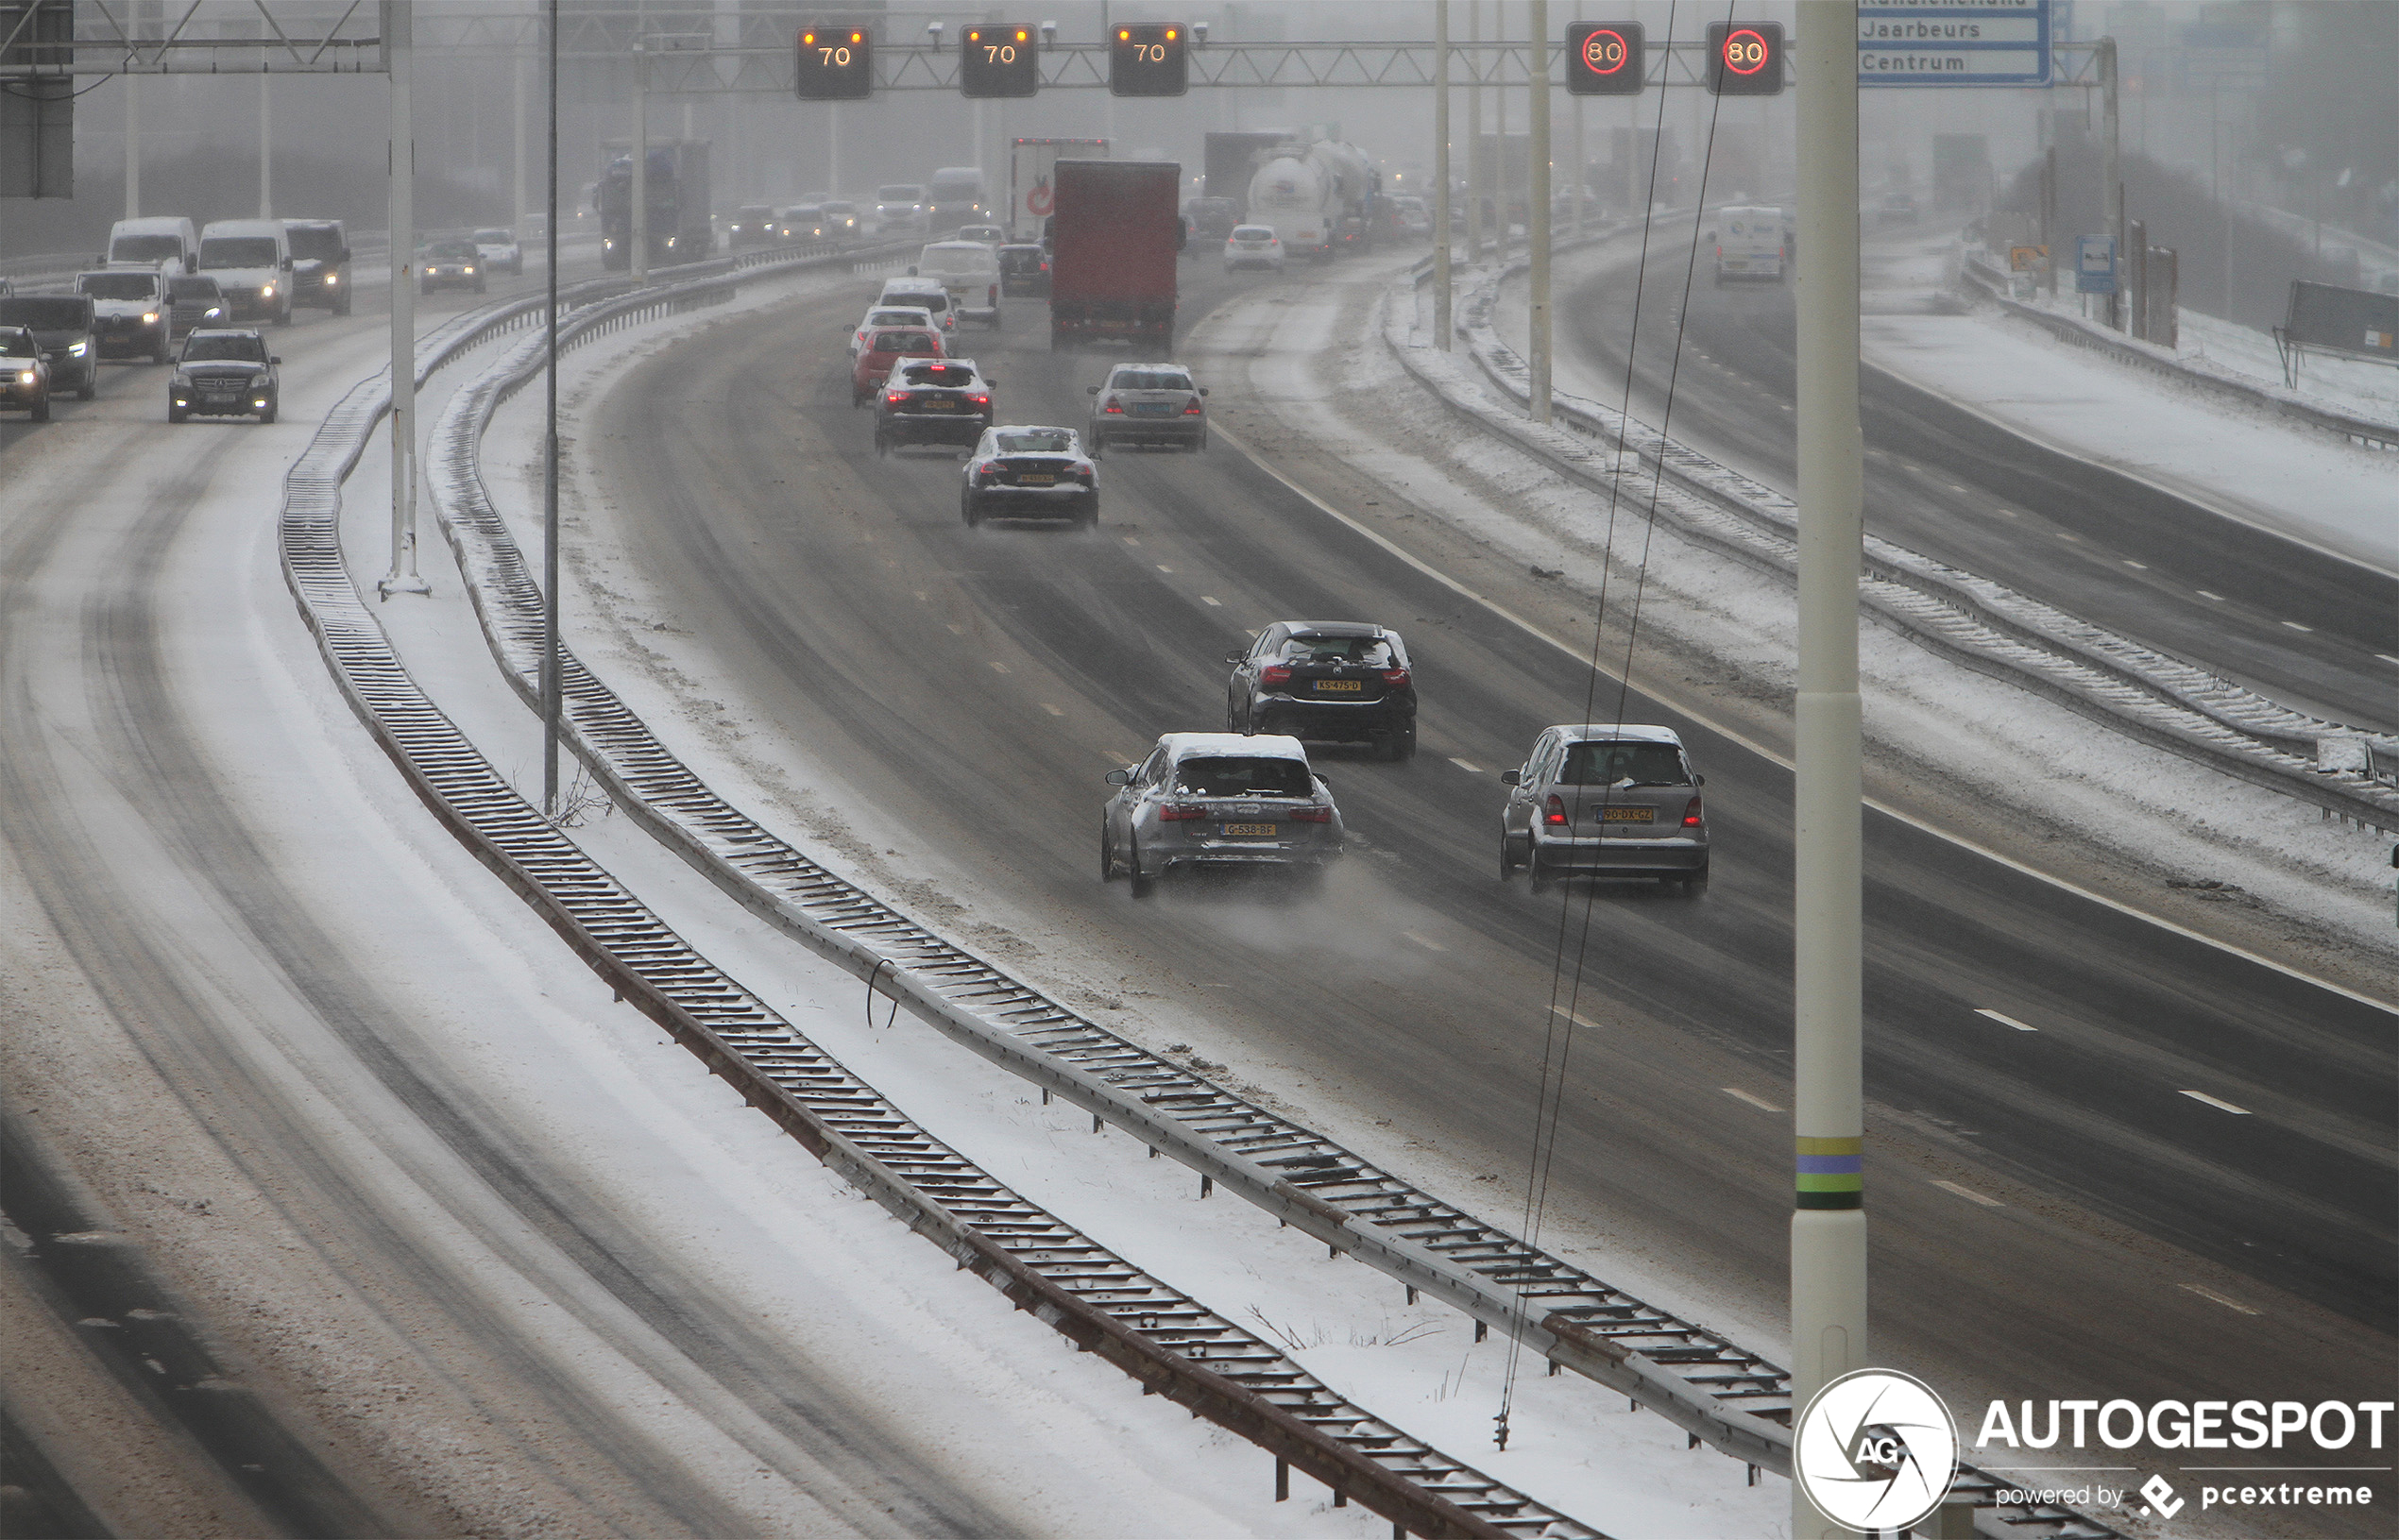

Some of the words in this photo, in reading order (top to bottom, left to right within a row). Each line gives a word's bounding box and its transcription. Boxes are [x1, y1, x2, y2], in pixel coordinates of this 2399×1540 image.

[1862, 21, 1981, 38] Jaarbeurs
[818, 46, 851, 66] 70
[983, 44, 1016, 64] 70
[1133, 43, 1165, 62] 70
[1587, 42, 1623, 62] 80
[1727, 42, 1763, 63] 80
[1862, 54, 1965, 71] Centrum
[1319, 682, 1359, 690] KS-475-D
[1605, 809, 1651, 820] 90-DX-GZ
